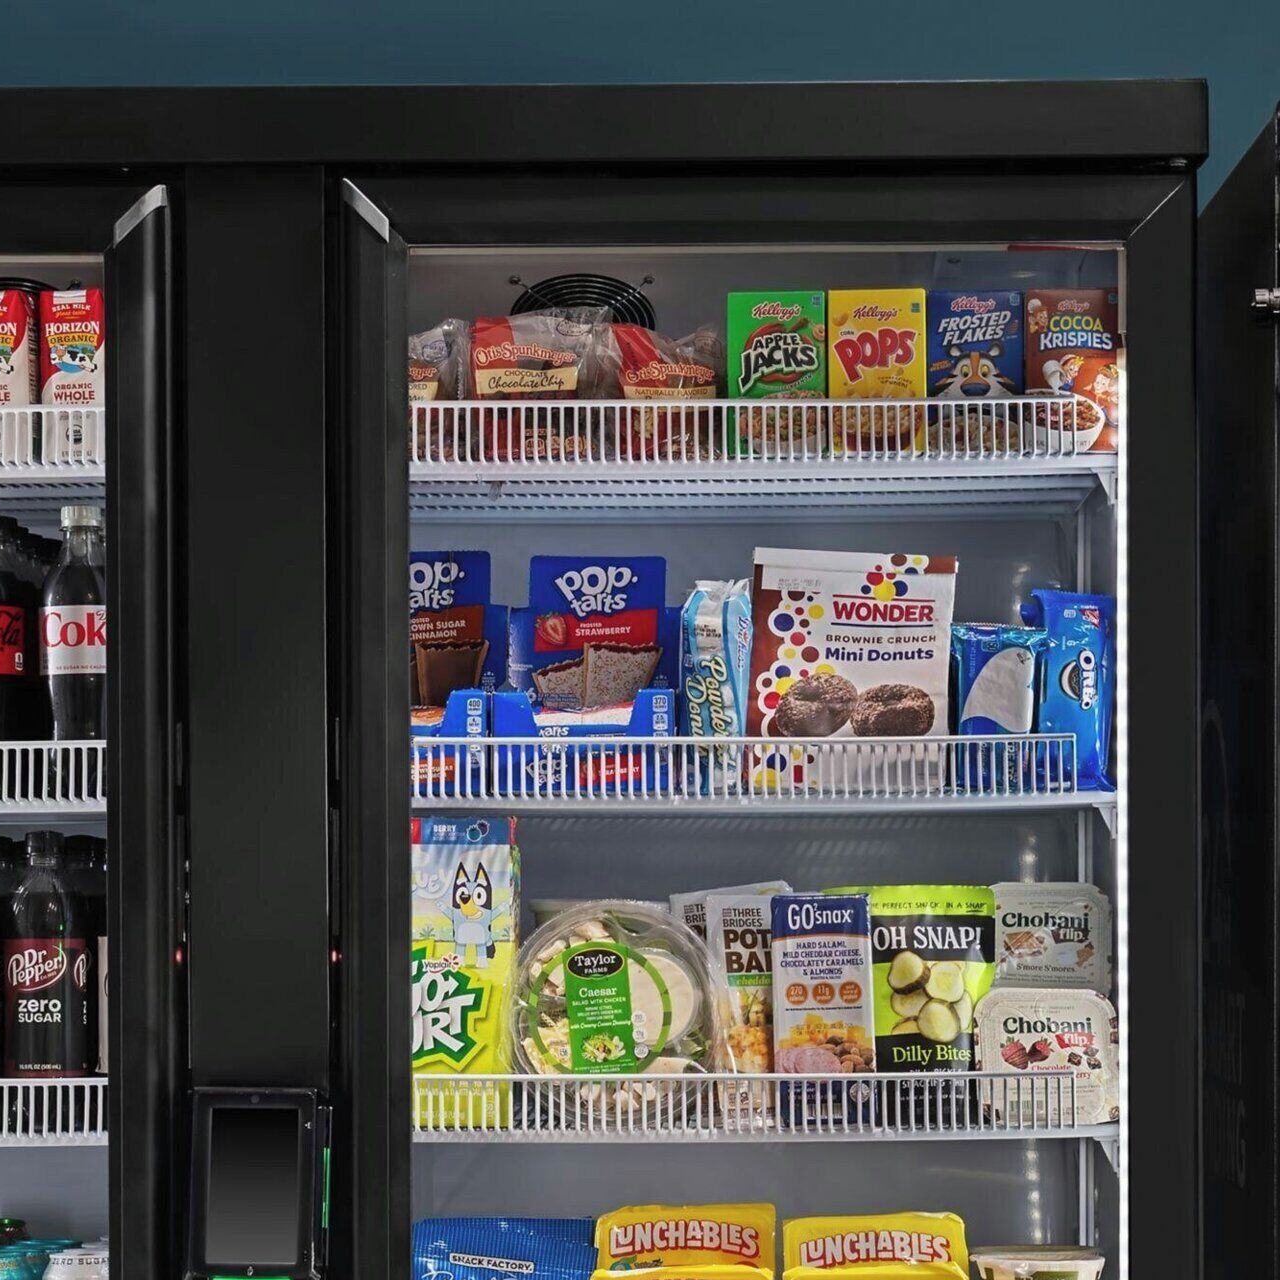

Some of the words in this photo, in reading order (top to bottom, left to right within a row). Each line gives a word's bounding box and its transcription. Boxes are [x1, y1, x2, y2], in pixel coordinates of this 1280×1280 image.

[752, 301, 801, 320] Kellogg's
[853, 305, 898, 322] Kellogg's
[45, 321, 99, 337] HORIZON
[939, 311, 1012, 333] FROSTED
[1049, 313, 1103, 332] COCOA
[753, 334, 801, 352] APPLE
[943, 325, 1006, 346] FLAKES
[1040, 331, 1113, 350] KRISPIES
[833, 329, 917, 382] POPS
[738, 344, 818, 390] JACKS
[54, 390, 95, 401] WHOLE
[571, 591, 627, 617] tarts
[833, 601, 934, 623] WONDER
[575, 626, 631, 637] STRAWBERRY
[826, 634, 883, 643] BROWNIE
[887, 634, 936, 643] CRUNCH
[825, 646, 865, 661] Mini
[867, 646, 934, 661] Donuts
[1079, 650, 1099, 710] OREO
[1002, 912, 1090, 930] Chobani
[874, 927, 909, 949] OH
[914, 926, 983, 950] SNAP!
[573, 954, 616, 968] Taylor
[780, 959, 823, 968] CHOCOLATEY
[824, 958, 864, 967] CARAMELS
[578, 985, 617, 997] Caesar
[603, 996, 627, 1004] CHICKEN
[18, 1000, 61, 1013] zero
[18, 1012, 61, 1023] SUGAR
[1002, 1018, 1093, 1035] Chobani
[892, 1046, 930, 1064] Dilly
[935, 1046, 972, 1062] Bites
[609, 1219, 761, 1259] LUNCHABLES
[799, 1230, 951, 1268] LUNCHABLES
